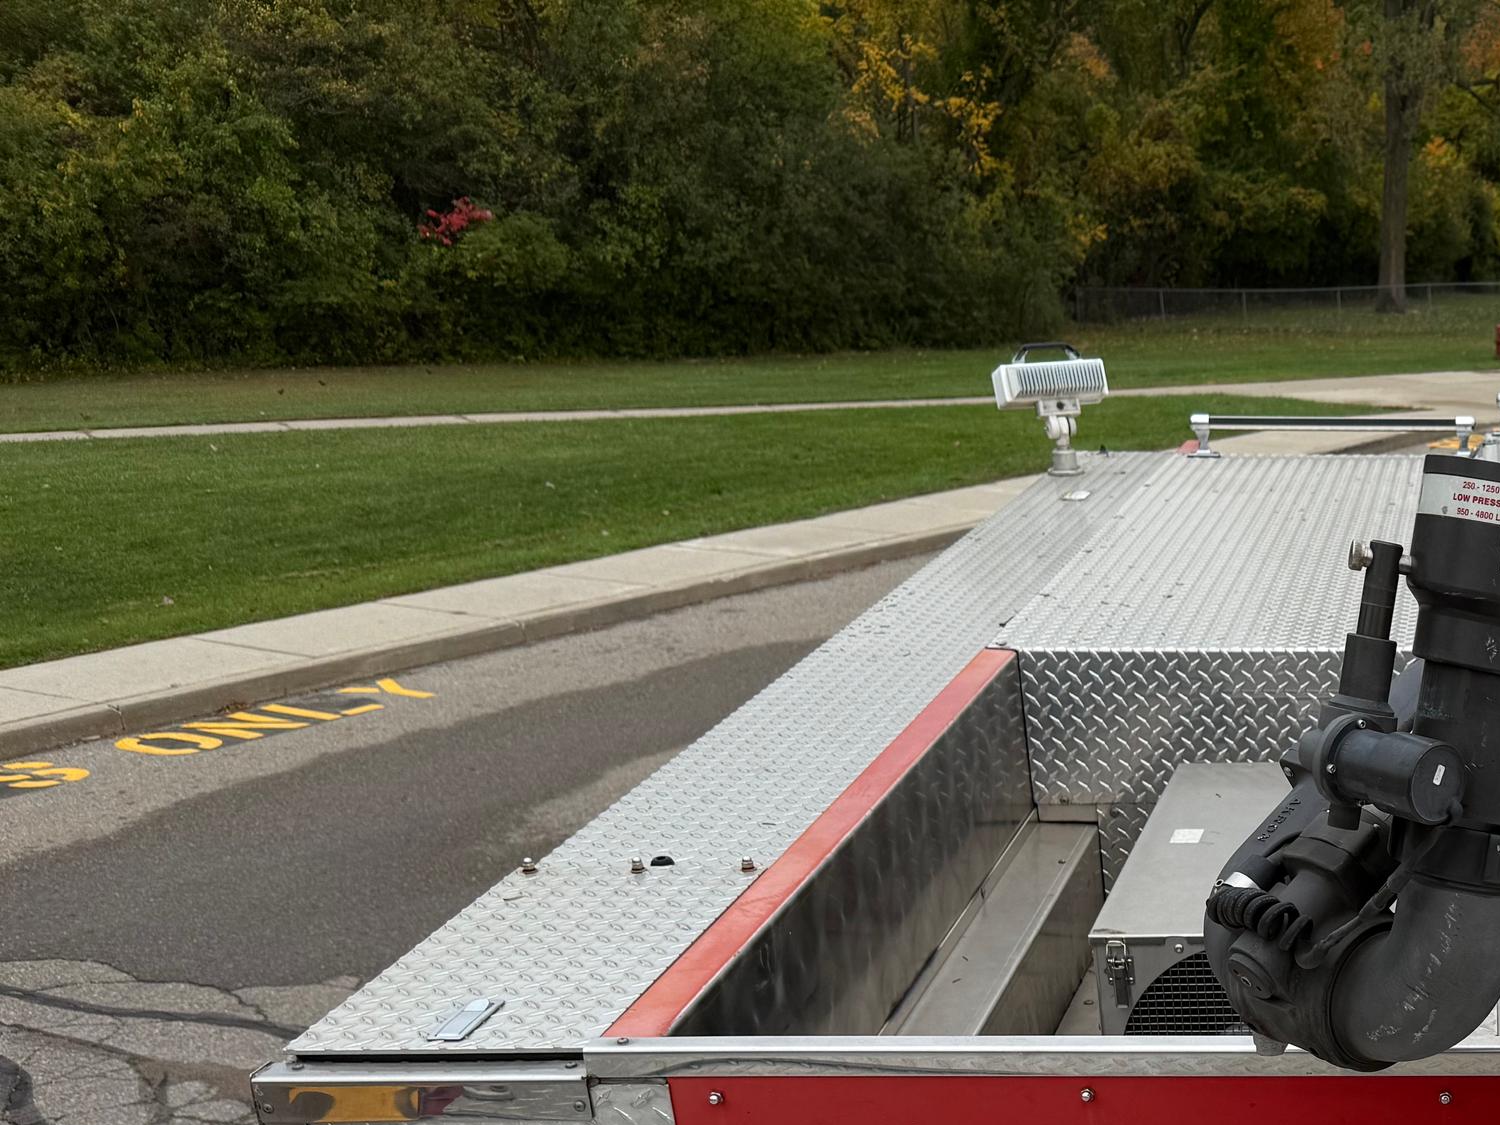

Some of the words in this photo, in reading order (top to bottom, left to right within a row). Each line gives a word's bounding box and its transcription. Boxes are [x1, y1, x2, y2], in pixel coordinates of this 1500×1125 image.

[1462, 481, 1476, 490] 250
[1482, 484, 1500, 494] 1250
[1453, 493, 1471, 503] LOW
[1456, 507, 1469, 516] 950
[1475, 509, 1494, 520] 4800
[114, 677, 436, 755] ONLY
[1257, 798, 1302, 842] AKRON
